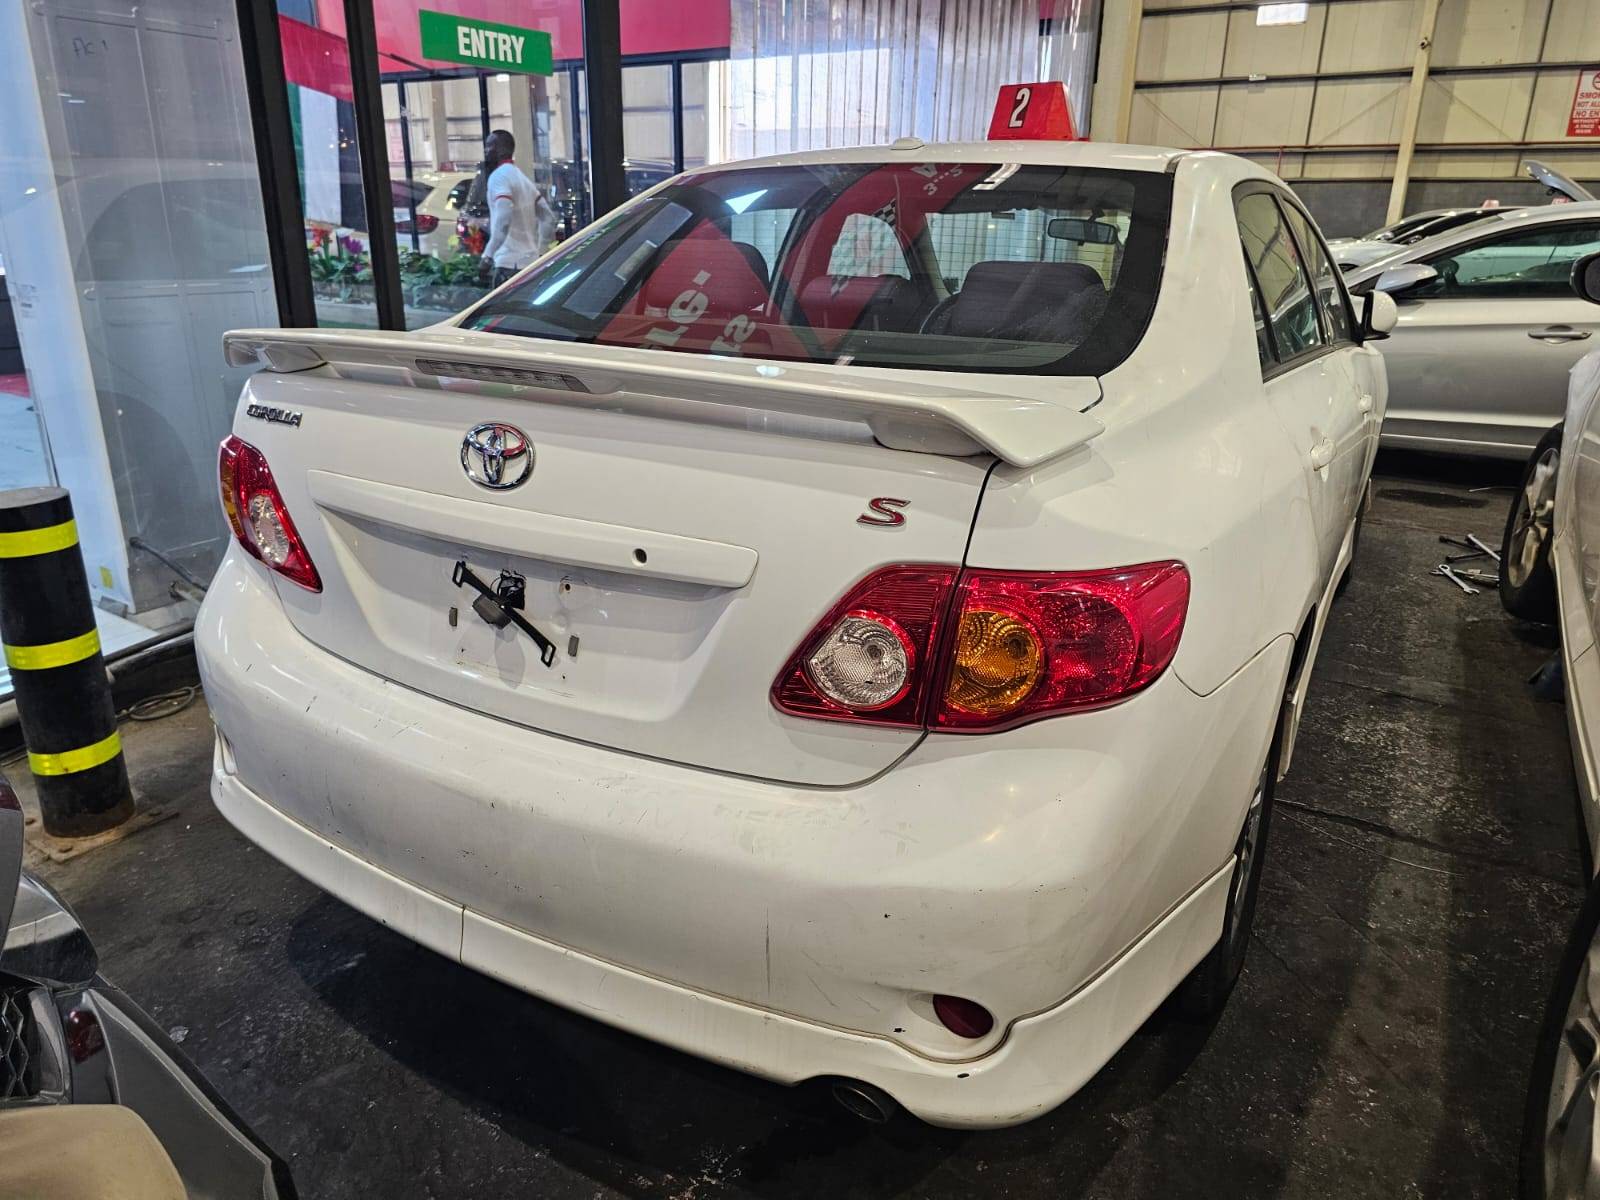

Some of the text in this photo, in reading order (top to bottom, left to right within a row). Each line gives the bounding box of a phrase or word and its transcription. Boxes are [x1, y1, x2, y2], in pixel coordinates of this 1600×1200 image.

[457, 25, 525, 64] ENTRY
[1009, 87, 1031, 128] 2
[856, 497, 912, 527] S
